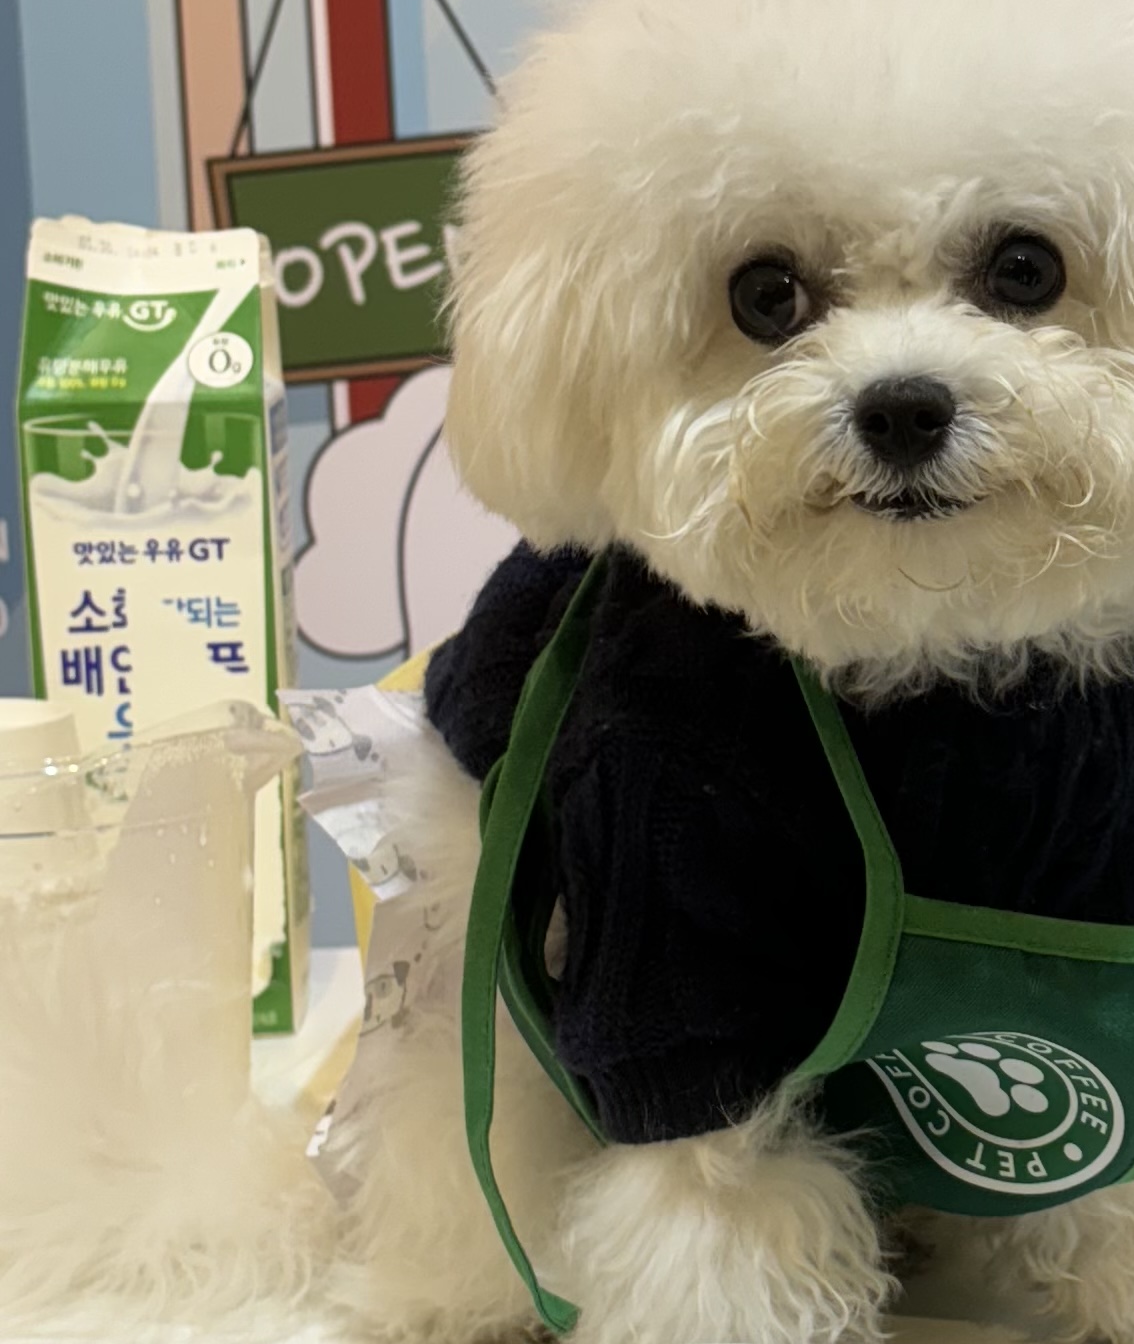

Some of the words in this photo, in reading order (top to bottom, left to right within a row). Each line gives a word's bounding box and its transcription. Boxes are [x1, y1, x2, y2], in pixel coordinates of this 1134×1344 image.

[129, 300, 168, 321] GT
[189, 538, 230, 561] GT
[965, 1141, 1048, 1178] PET
